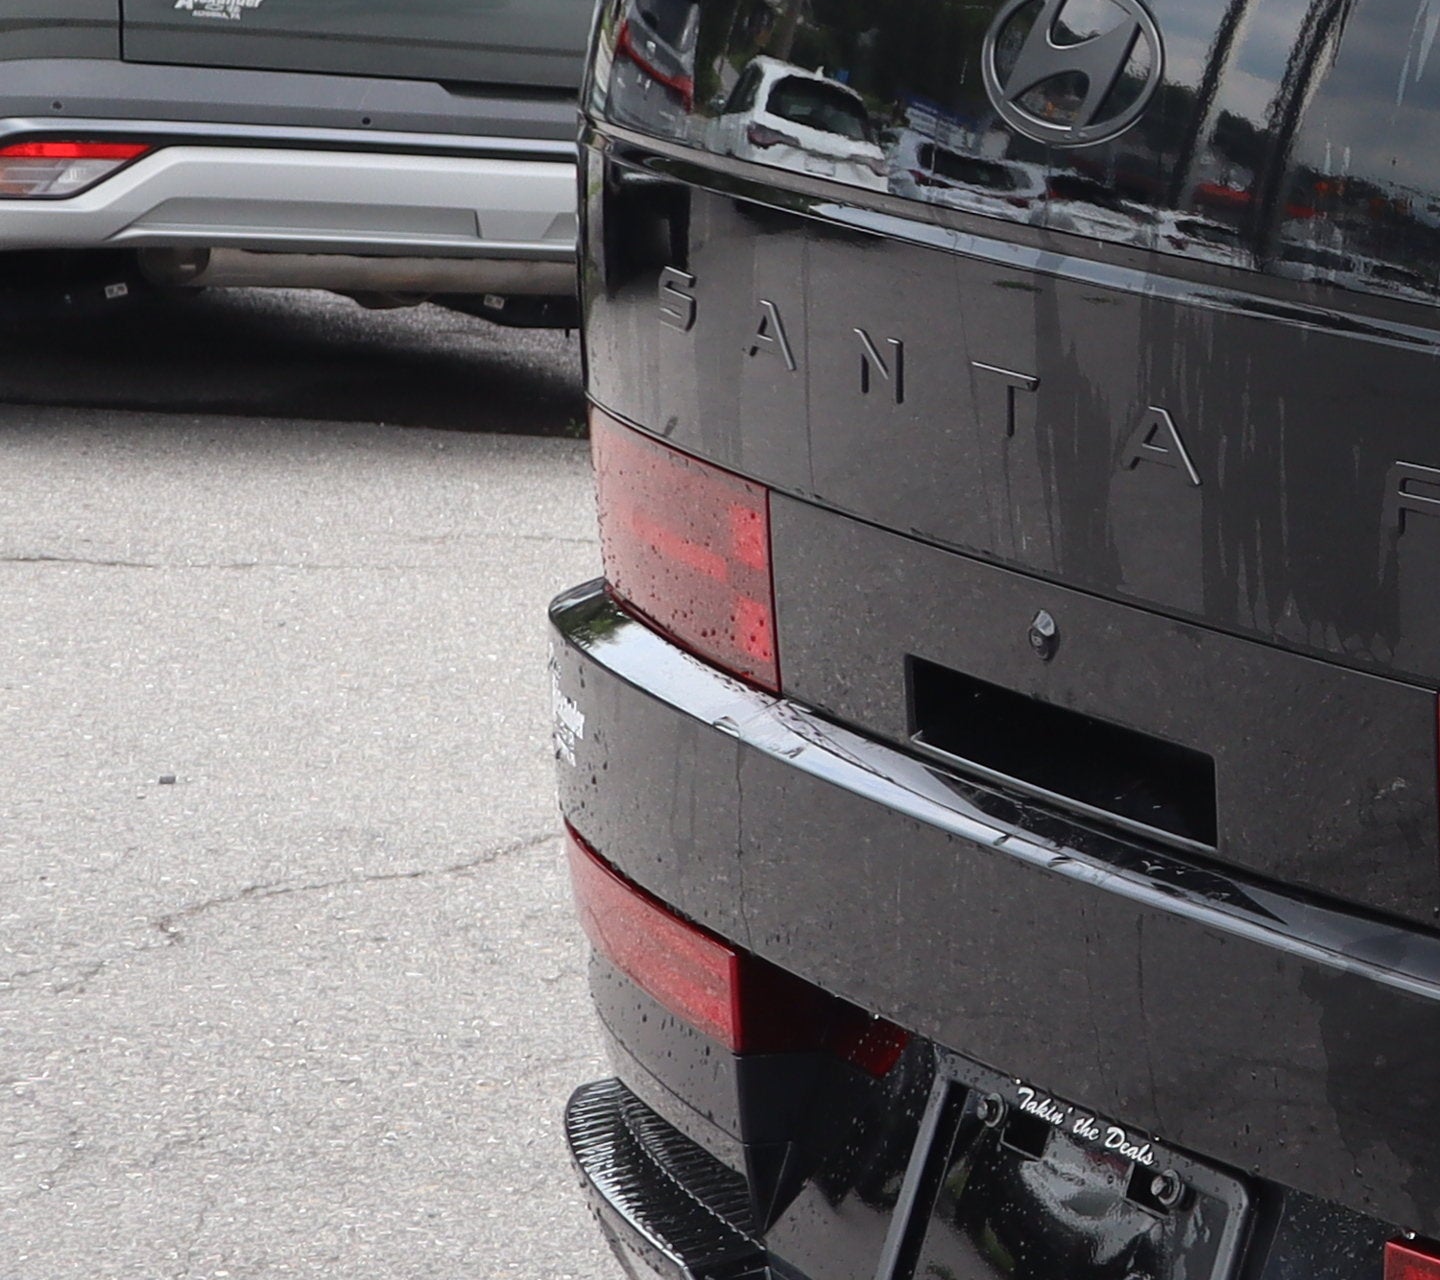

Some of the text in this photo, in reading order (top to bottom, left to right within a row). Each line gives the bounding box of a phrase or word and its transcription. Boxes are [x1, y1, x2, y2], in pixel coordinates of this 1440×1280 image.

[658, 266, 1200, 486] SANTA
[1018, 1086, 1154, 1165] Takin' the Deals
